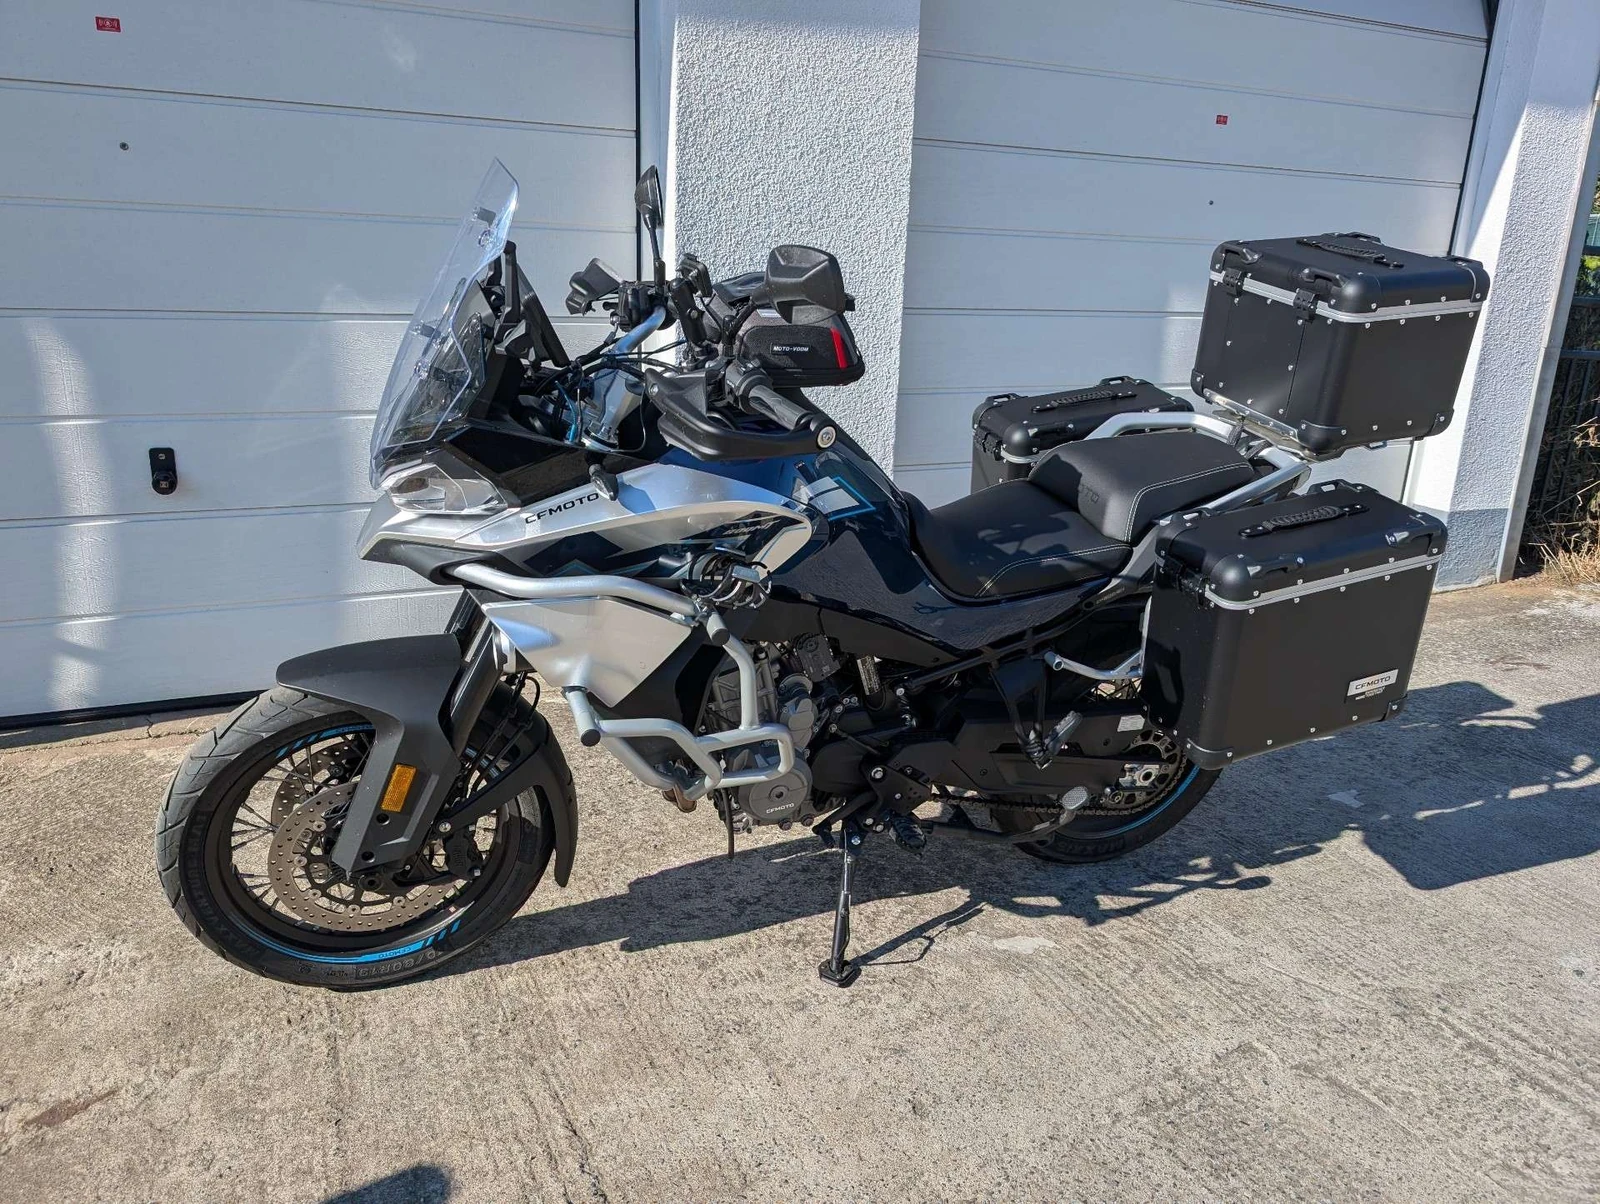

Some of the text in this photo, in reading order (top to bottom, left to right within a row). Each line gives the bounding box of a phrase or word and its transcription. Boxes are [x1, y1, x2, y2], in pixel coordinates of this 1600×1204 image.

[525, 492, 600, 524] CFMOTO
[1355, 676, 1391, 690] CFMOTO
[766, 802, 795, 814] CFMOTO
[378, 947, 412, 959] CFMOTO
